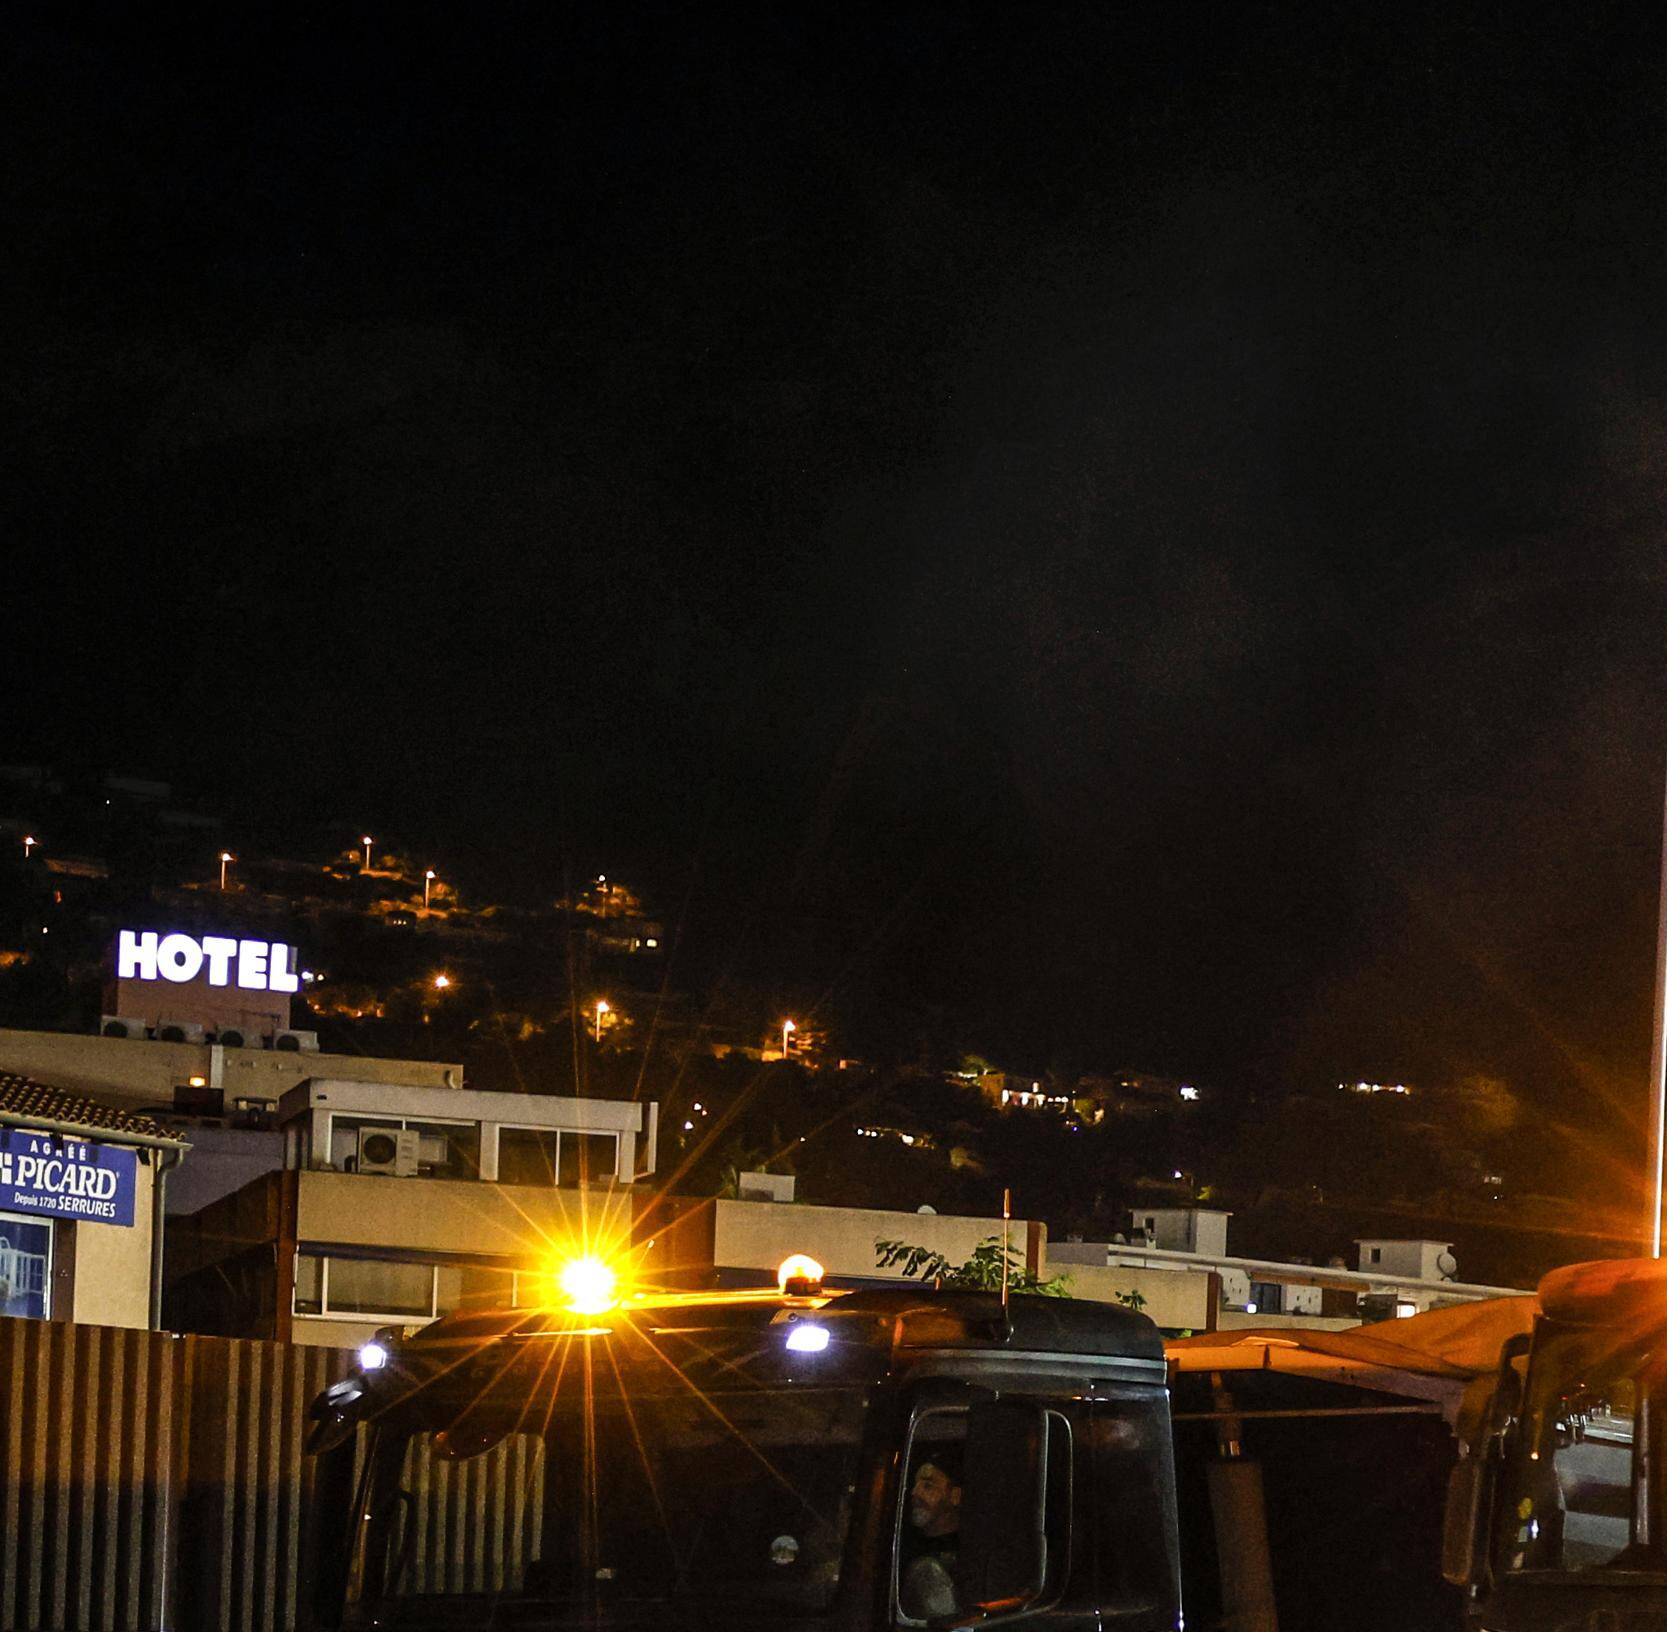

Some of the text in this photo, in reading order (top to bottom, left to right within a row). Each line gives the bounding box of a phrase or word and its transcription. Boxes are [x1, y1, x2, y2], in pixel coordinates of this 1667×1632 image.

[118, 930, 299, 992] HOTEL
[15, 1155, 117, 1199] PICARD
[14, 1192, 116, 1218] Depuis 1720 SERRURES
